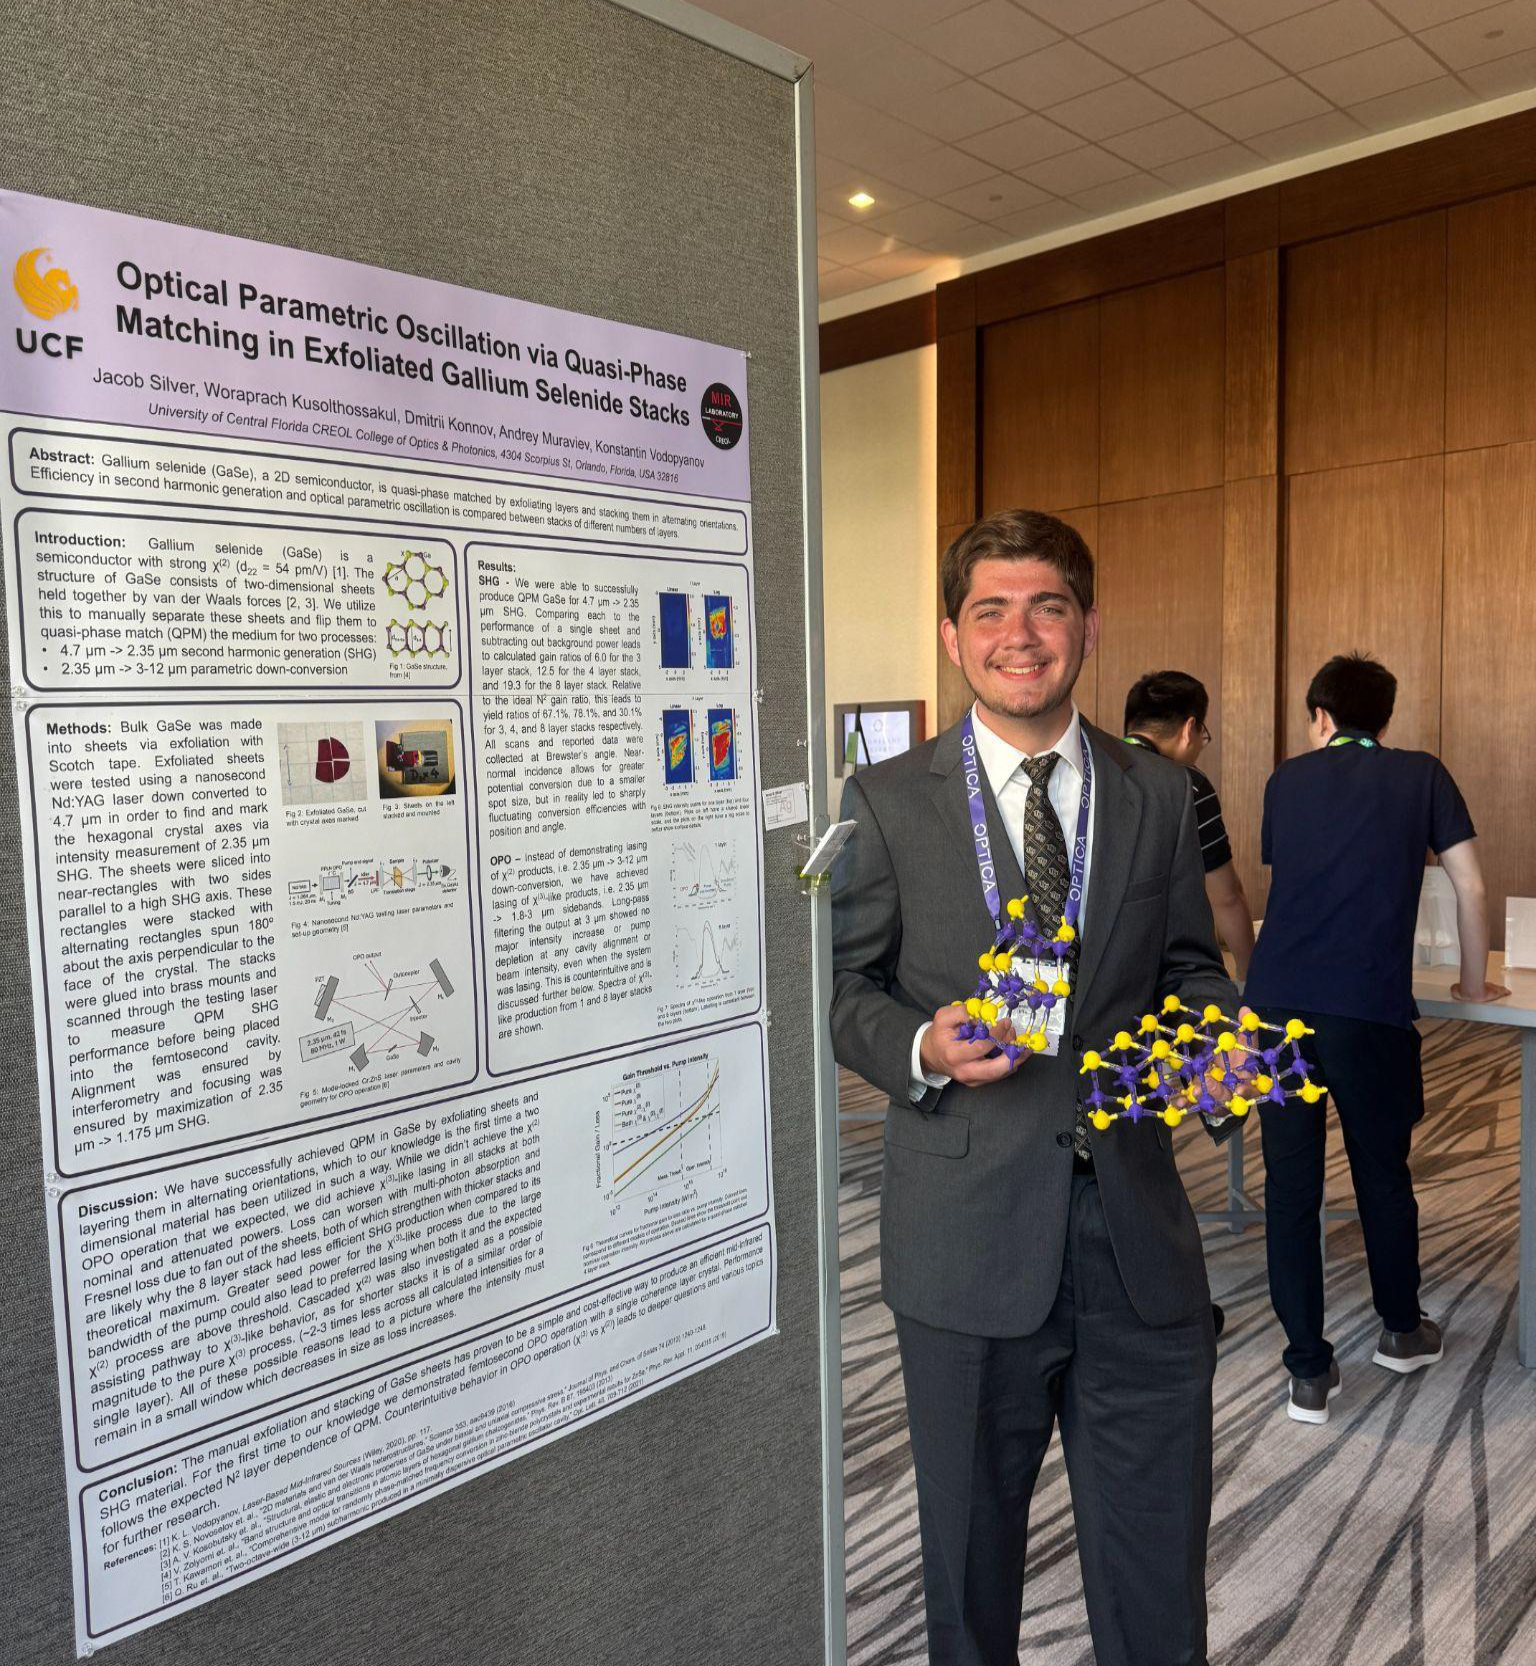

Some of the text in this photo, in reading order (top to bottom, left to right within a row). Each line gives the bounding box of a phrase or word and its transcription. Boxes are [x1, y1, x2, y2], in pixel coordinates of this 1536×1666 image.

[117, 261, 686, 392] Optical Parametric Oscillation via Quasi-Phase
[16, 328, 83, 359] UCF
[117, 304, 690, 426] Matching in Exfoliated Gallium Selenide Stacks
[705, 407, 739, 419] LABORATORY
[711, 391, 731, 407] MIR
[93, 368, 704, 468] Jacob Silver, Woraprach Kusolthossakul, Dmitrii Konnov, Andrey Muraviev, Konstantin Vodopyanov
[149, 403, 208, 424] University
[212, 412, 223, 422] of
[227, 413, 268, 428] Central
[272, 419, 308, 432] Florida
[312, 424, 352, 438] CREOL
[356, 430, 394, 445] College
[397, 437, 406, 445] of
[409, 438, 438, 450] Optics
[442, 442, 448, 451] &
[452, 443, 497, 459] Photonics,
[500, 450, 521, 461] 4304
[525, 453, 560, 466] Scorpius
[576, 460, 607, 474] Orlando,
[610, 464, 636, 478] Florida,
[639, 469, 655, 480] USA
[30, 447, 738, 531] Abstract: Gallium selenide (GaSe), a 2D semiconductor, is quasi-phase matched by exfoliating layers and stacking them in alternating orientations.
[35, 532, 373, 563] Introduction: Gallium selenide (GaSe) is a
[478, 560, 516, 572] Results:
[479, 575, 499, 586] SHG
[515, 577, 529, 588] We
[560, 581, 577, 591] able
[582, 582, 589, 592] to
[594, 584, 638, 596] successfully
[41, 626, 376, 644] quasi-phase match (QPM) the medium for two processes:
[46, 718, 262, 735] Methods: Bulk GaSe was made
[48, 735, 263, 754] into sheets via exfoliation with
[962, 735, 981, 799] OPTICA
[52, 786, 267, 809] Nd:YAG laser down converted to
[490, 855, 511, 866] OPO
[525, 850, 554, 862] Instead
[558, 848, 566, 858] of
[570, 844, 622, 857] demonstrating
[626, 841, 647, 851] lasing
[974, 823, 996, 893] OPTICA
[1069, 836, 1086, 902] OPTICA
[499, 1023, 543, 1039] are shown.
[78, 1091, 538, 1218] Discussion: We have successfully achieved QPM in GaSe by exfoliating sheets and
[99, 1232, 762, 1502] Conclusion: The manual exfoliation and stacking of GaSe sheets has proven to be a simple and cost-effective way to produce an efficient mid-infrared
[102, 1500, 220, 1555] for further research.
[104, 1544, 156, 1570] References:
